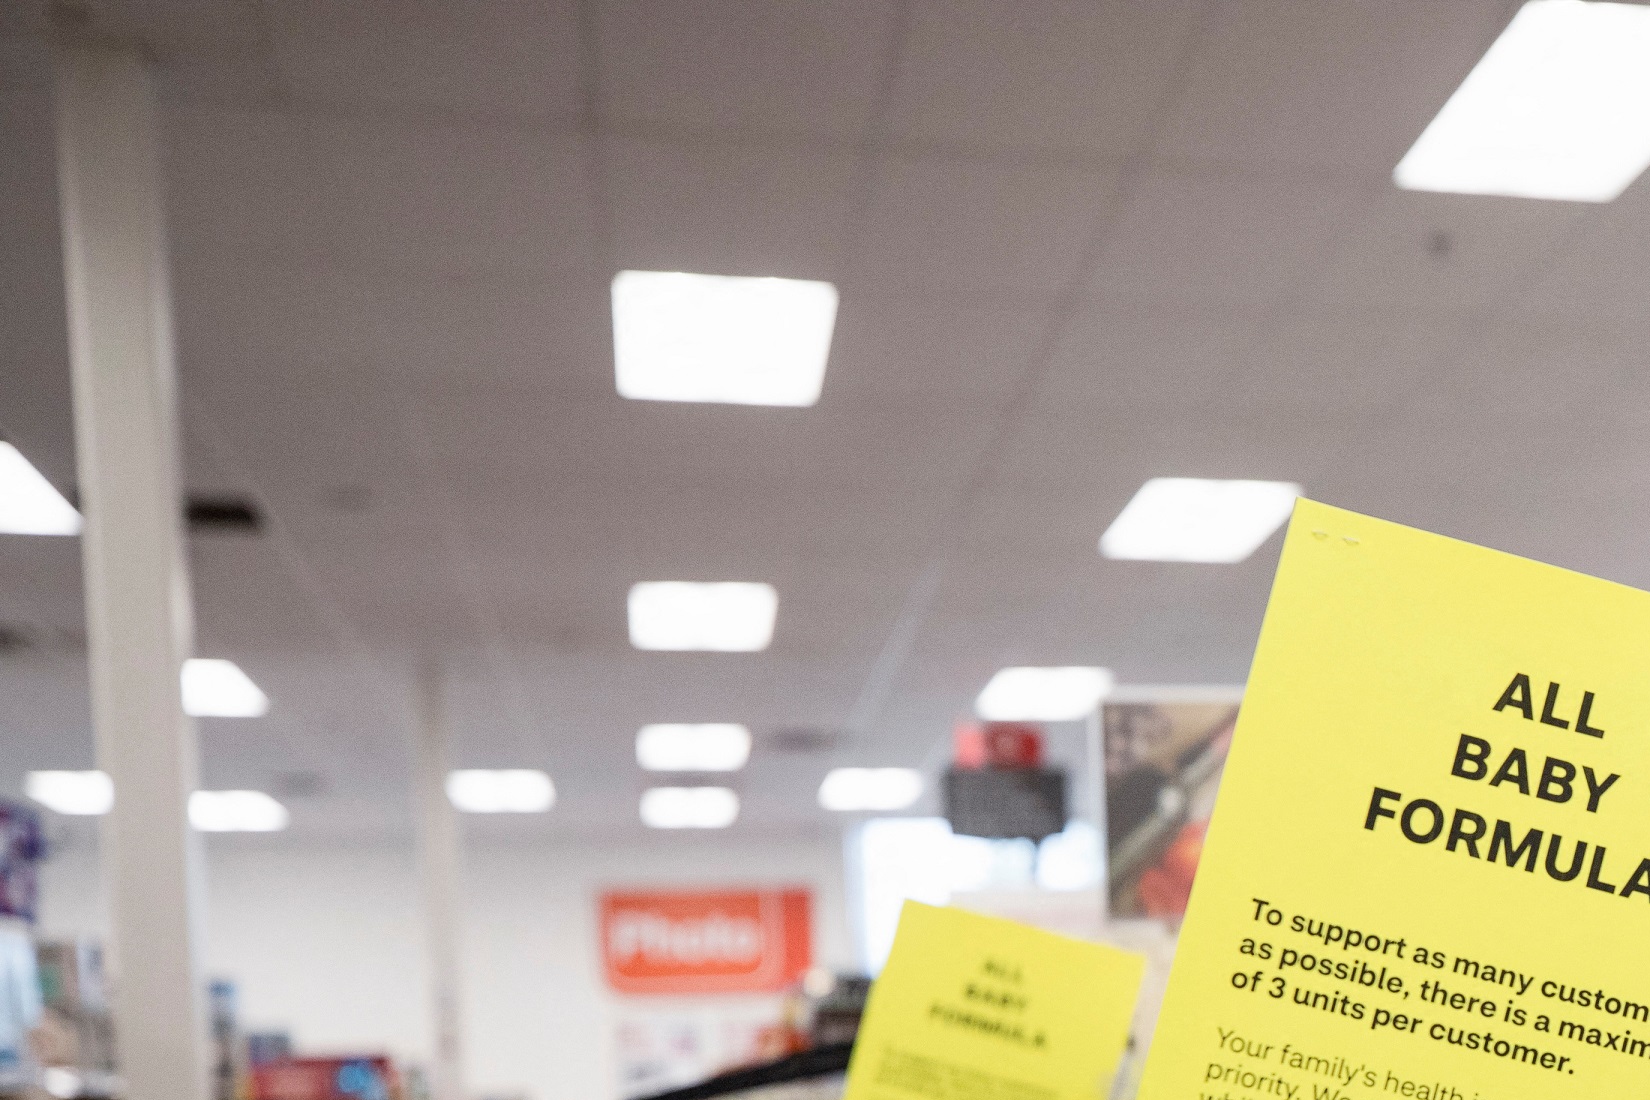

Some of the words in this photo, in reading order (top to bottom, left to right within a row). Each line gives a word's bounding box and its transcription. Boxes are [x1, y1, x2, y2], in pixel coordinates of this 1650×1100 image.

[1492, 672, 1604, 738] ALL
[1450, 733, 1621, 813] BABY
[1239, 938, 1272, 959] as
[1278, 948, 1409, 999] possible,
[1420, 980, 1496, 1017] there
[1503, 999, 1527, 1025] is
[1533, 1014, 1549, 1032] a
[1252, 897, 1283, 925] To
[1290, 915, 1406, 958] support
[1412, 947, 1445, 968] as
[1452, 957, 1534, 995] many
[1218, 1027, 1273, 1058] Your
[1281, 1044, 1376, 1086] family's
[1230, 971, 1263, 991] of
[1268, 977, 1286, 998] 3
[1292, 987, 1365, 1019] units
[1370, 1008, 1423, 1033] per
[1429, 1023, 1573, 1074] customer.
